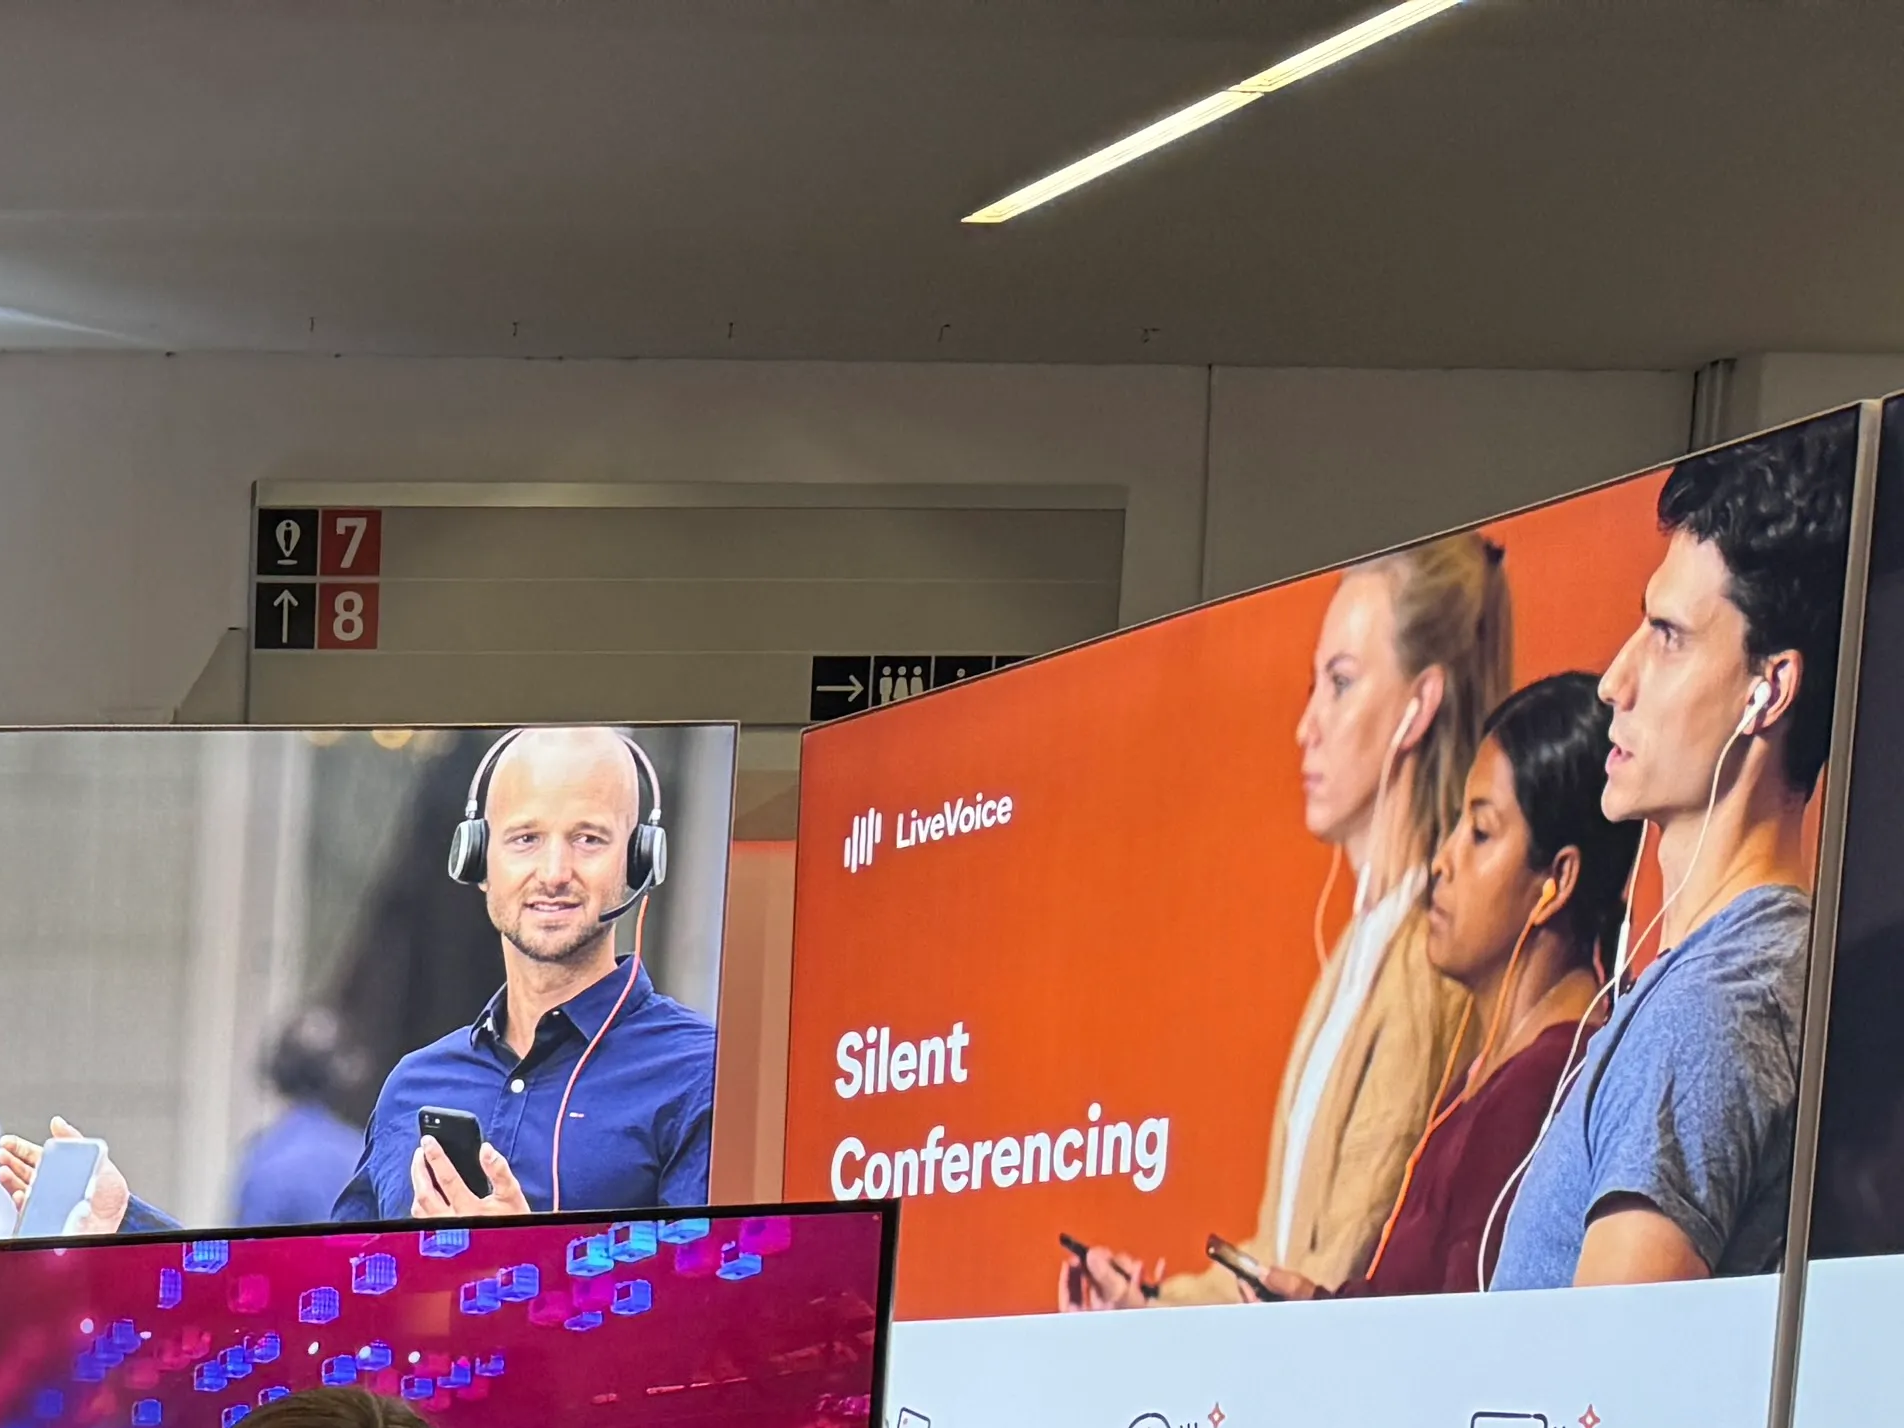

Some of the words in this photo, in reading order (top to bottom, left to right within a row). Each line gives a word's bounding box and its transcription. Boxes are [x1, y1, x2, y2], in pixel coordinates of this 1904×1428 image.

[335, 518, 369, 570] 7
[332, 590, 364, 641] 8
[896, 791, 1014, 849] LiveVoice
[834, 1020, 970, 1099] Silent
[830, 1102, 1170, 1201] Conferencing
